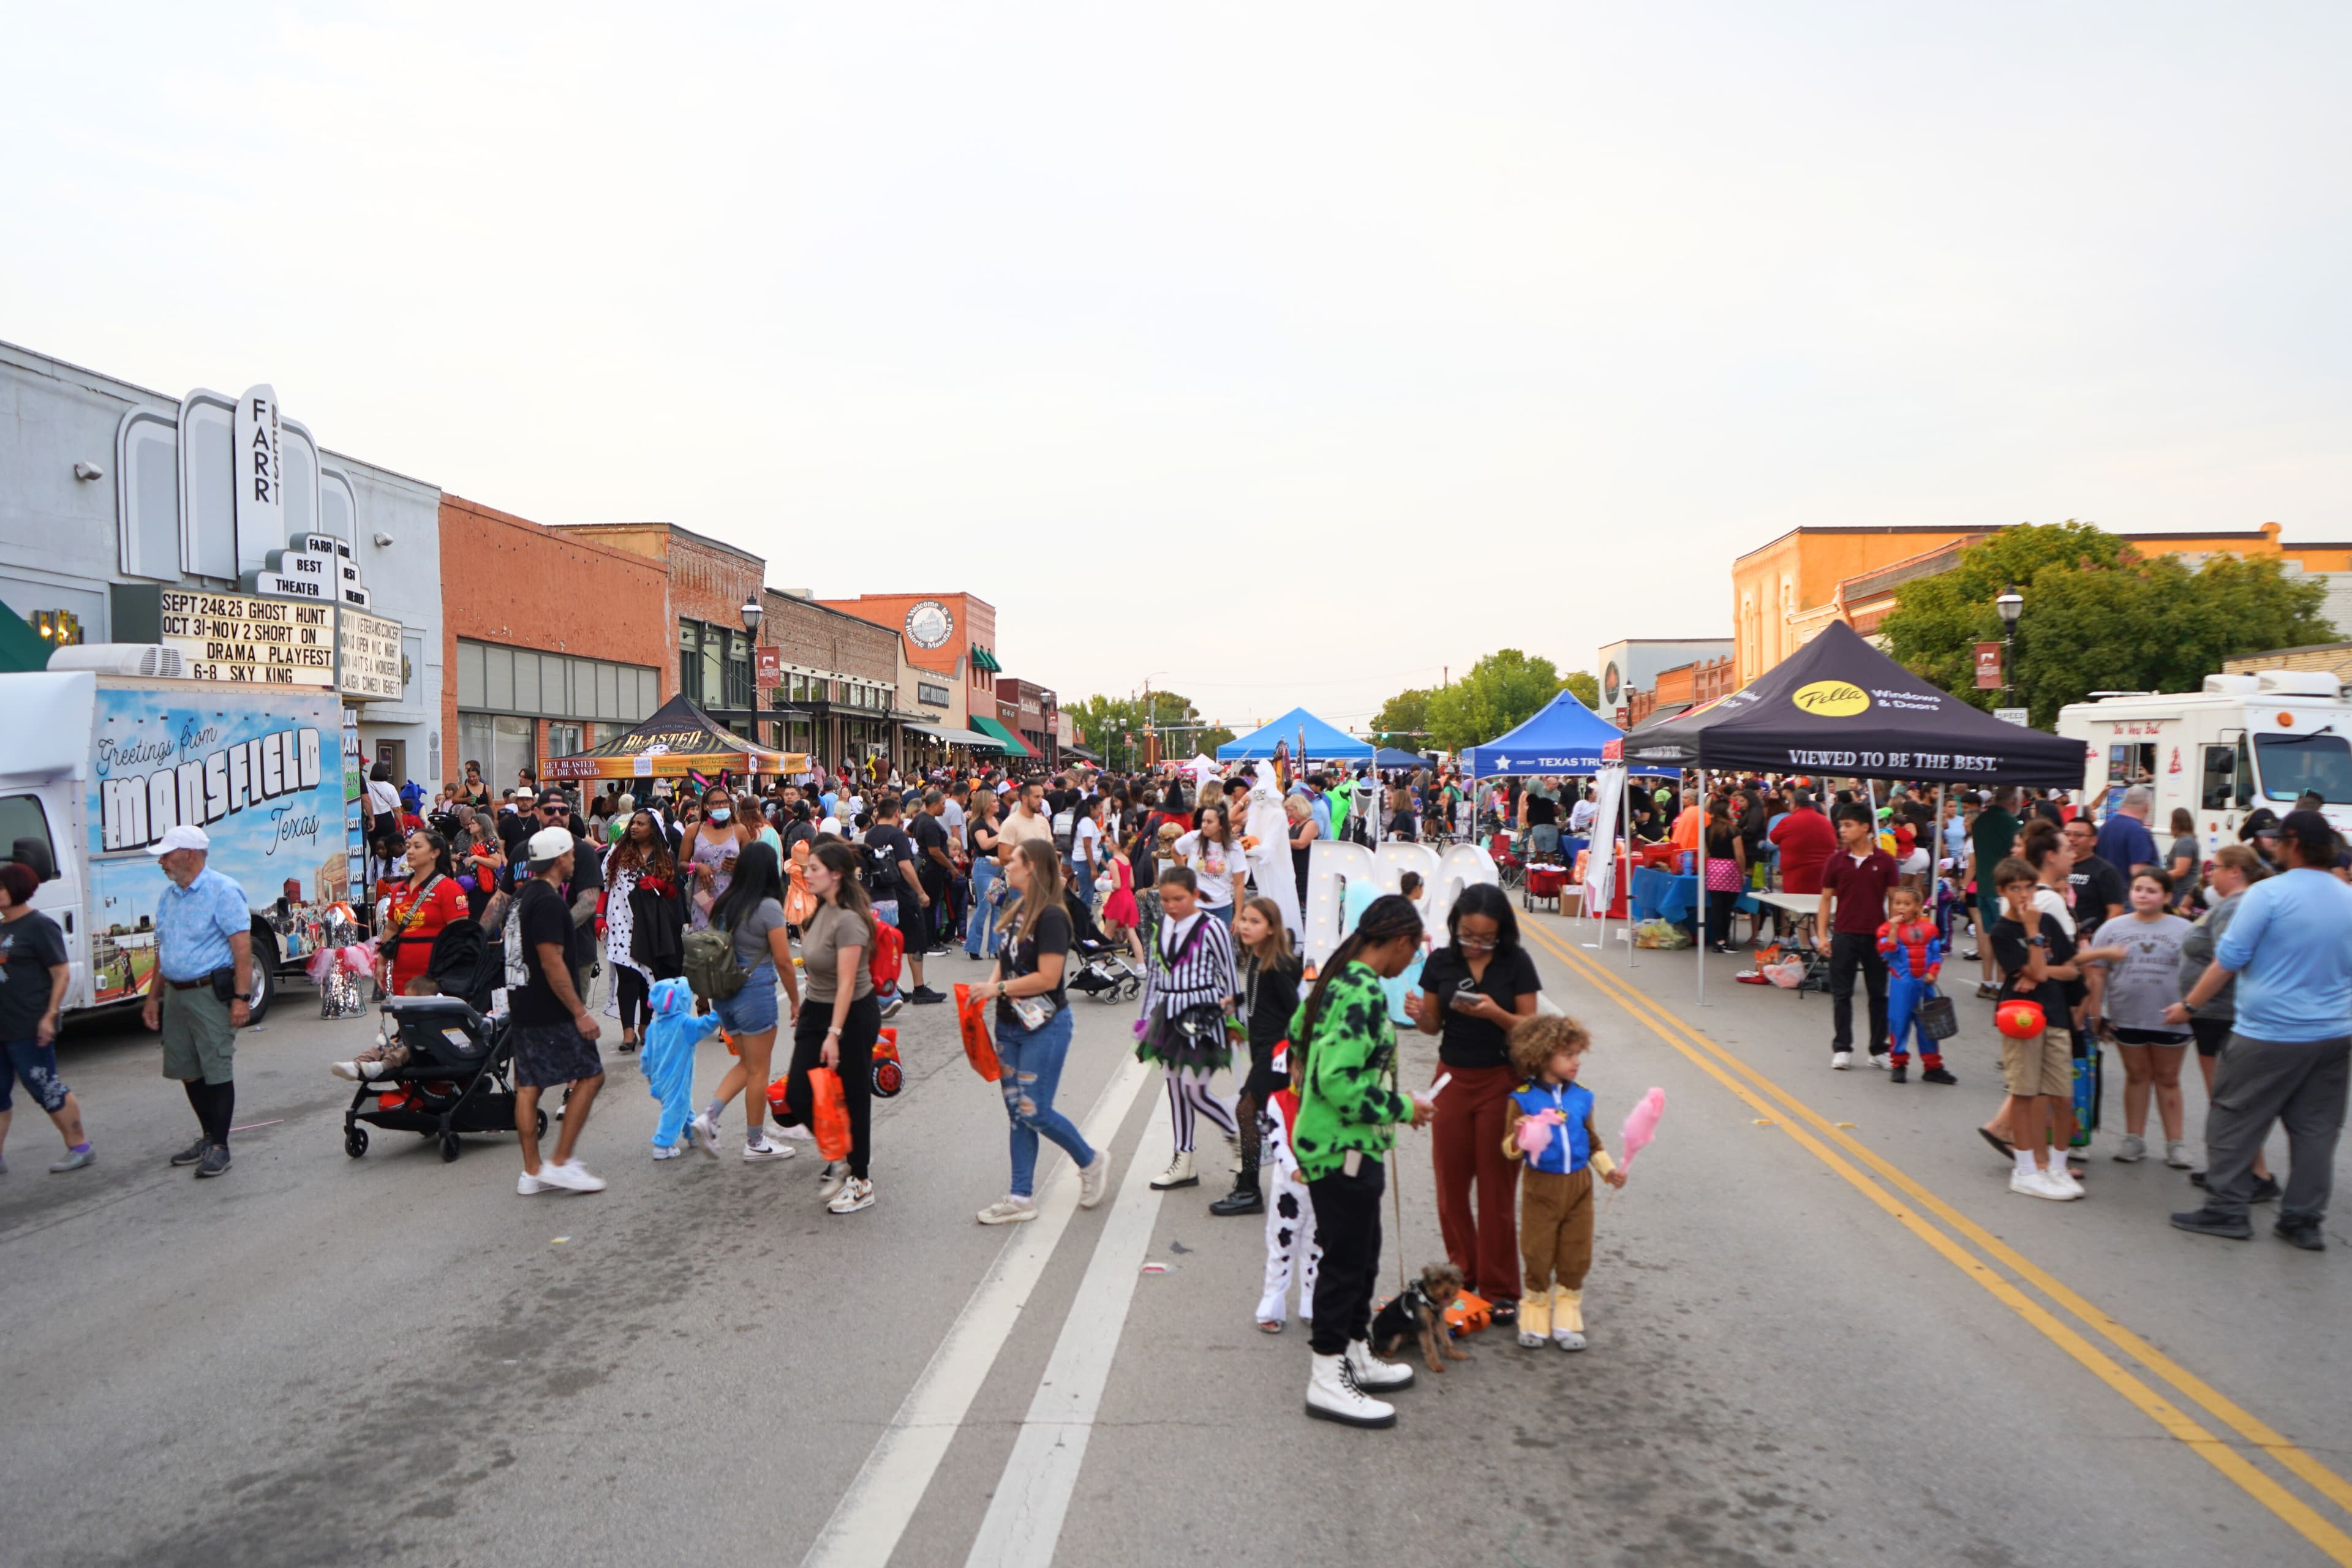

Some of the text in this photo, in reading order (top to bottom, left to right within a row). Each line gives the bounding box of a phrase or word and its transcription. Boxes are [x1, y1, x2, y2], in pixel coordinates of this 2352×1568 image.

[253, 398, 270, 502] FARR
[309, 539, 333, 554] FARR
[297, 559, 322, 573] BEST
[276, 579, 319, 597] THEATER
[162, 594, 197, 613] SEPT
[249, 603, 287, 621] GHOST
[296, 606, 325, 625] HUNT
[908, 601, 939, 616] Welcome
[163, 616, 189, 635] OCT
[243, 624, 251, 639] 2
[255, 624, 293, 643] SHORT
[301, 628, 316, 644] ON
[357, 617, 381, 637] VETERANS
[905, 624, 953, 649] Historic Mansfield
[356, 636, 369, 652] OPEN
[207, 642, 331, 666] DRAMA PLAYFEST
[194, 663, 293, 683] 6-8 SKY KING
[362, 676, 380, 692] COMEDY
[1800, 687, 1863, 708] Pella
[1871, 689, 1941, 703] Windows
[1893, 700, 1939, 710] Doors
[96, 725, 218, 776] Greetings from
[1789, 750, 1856, 766] VIEWED
[1860, 752, 1884, 766] TO
[1888, 753, 1910, 767] BE
[1914, 753, 1950, 769] THE
[562, 760, 595, 769] BLASTED
[574, 767, 600, 776] NAKED
[1538, 758, 1578, 766] TEXAS
[100, 727, 321, 853] MANSFIELD
[266, 801, 320, 856] Texas
